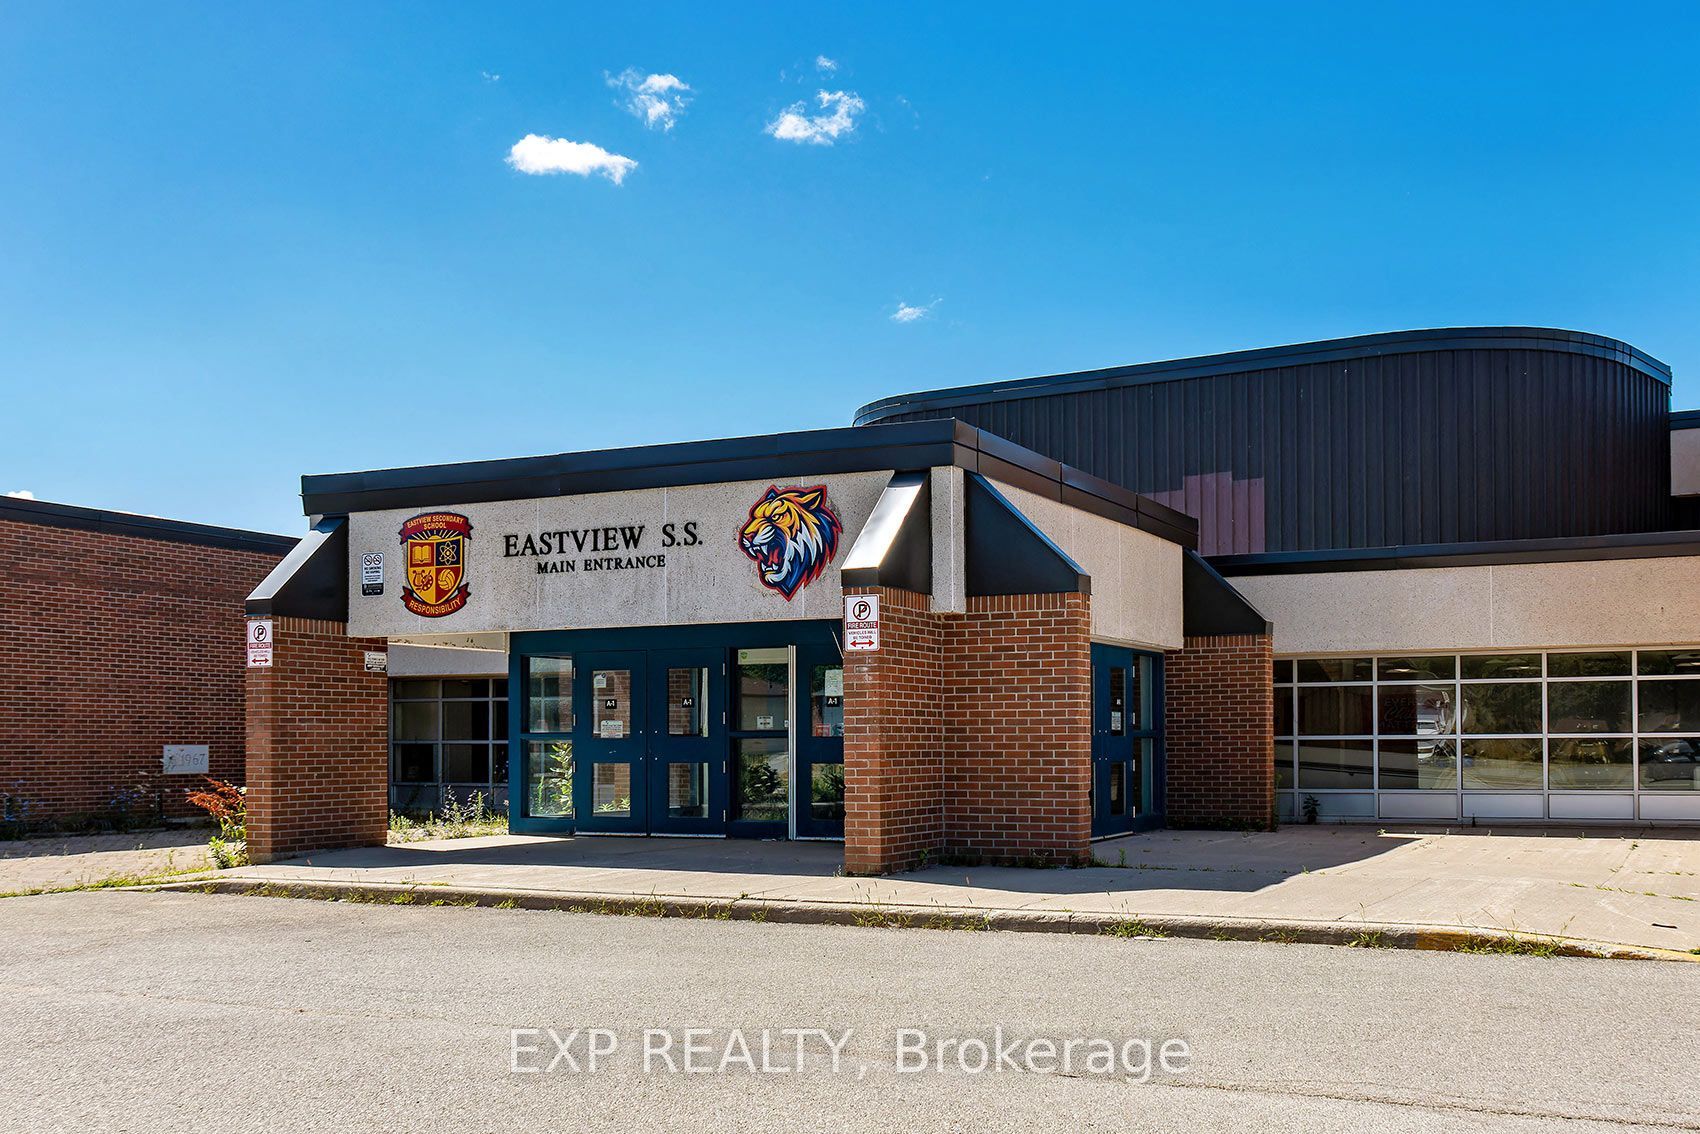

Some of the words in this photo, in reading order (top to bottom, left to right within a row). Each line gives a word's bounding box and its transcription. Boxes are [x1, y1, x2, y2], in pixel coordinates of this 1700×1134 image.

[407, 516, 432, 528] EASTVIEW
[432, 515, 464, 523] SECONDARY
[423, 522, 447, 530] SCHOOL
[503, 525, 645, 558] EASTVIEW
[661, 522, 704, 548] S.S.
[537, 560, 576, 574] MAIN
[583, 555, 666, 571] ENTRANCE
[409, 597, 461, 614] RESPONSIBILITY
[860, 621, 877, 629] ROUTE
